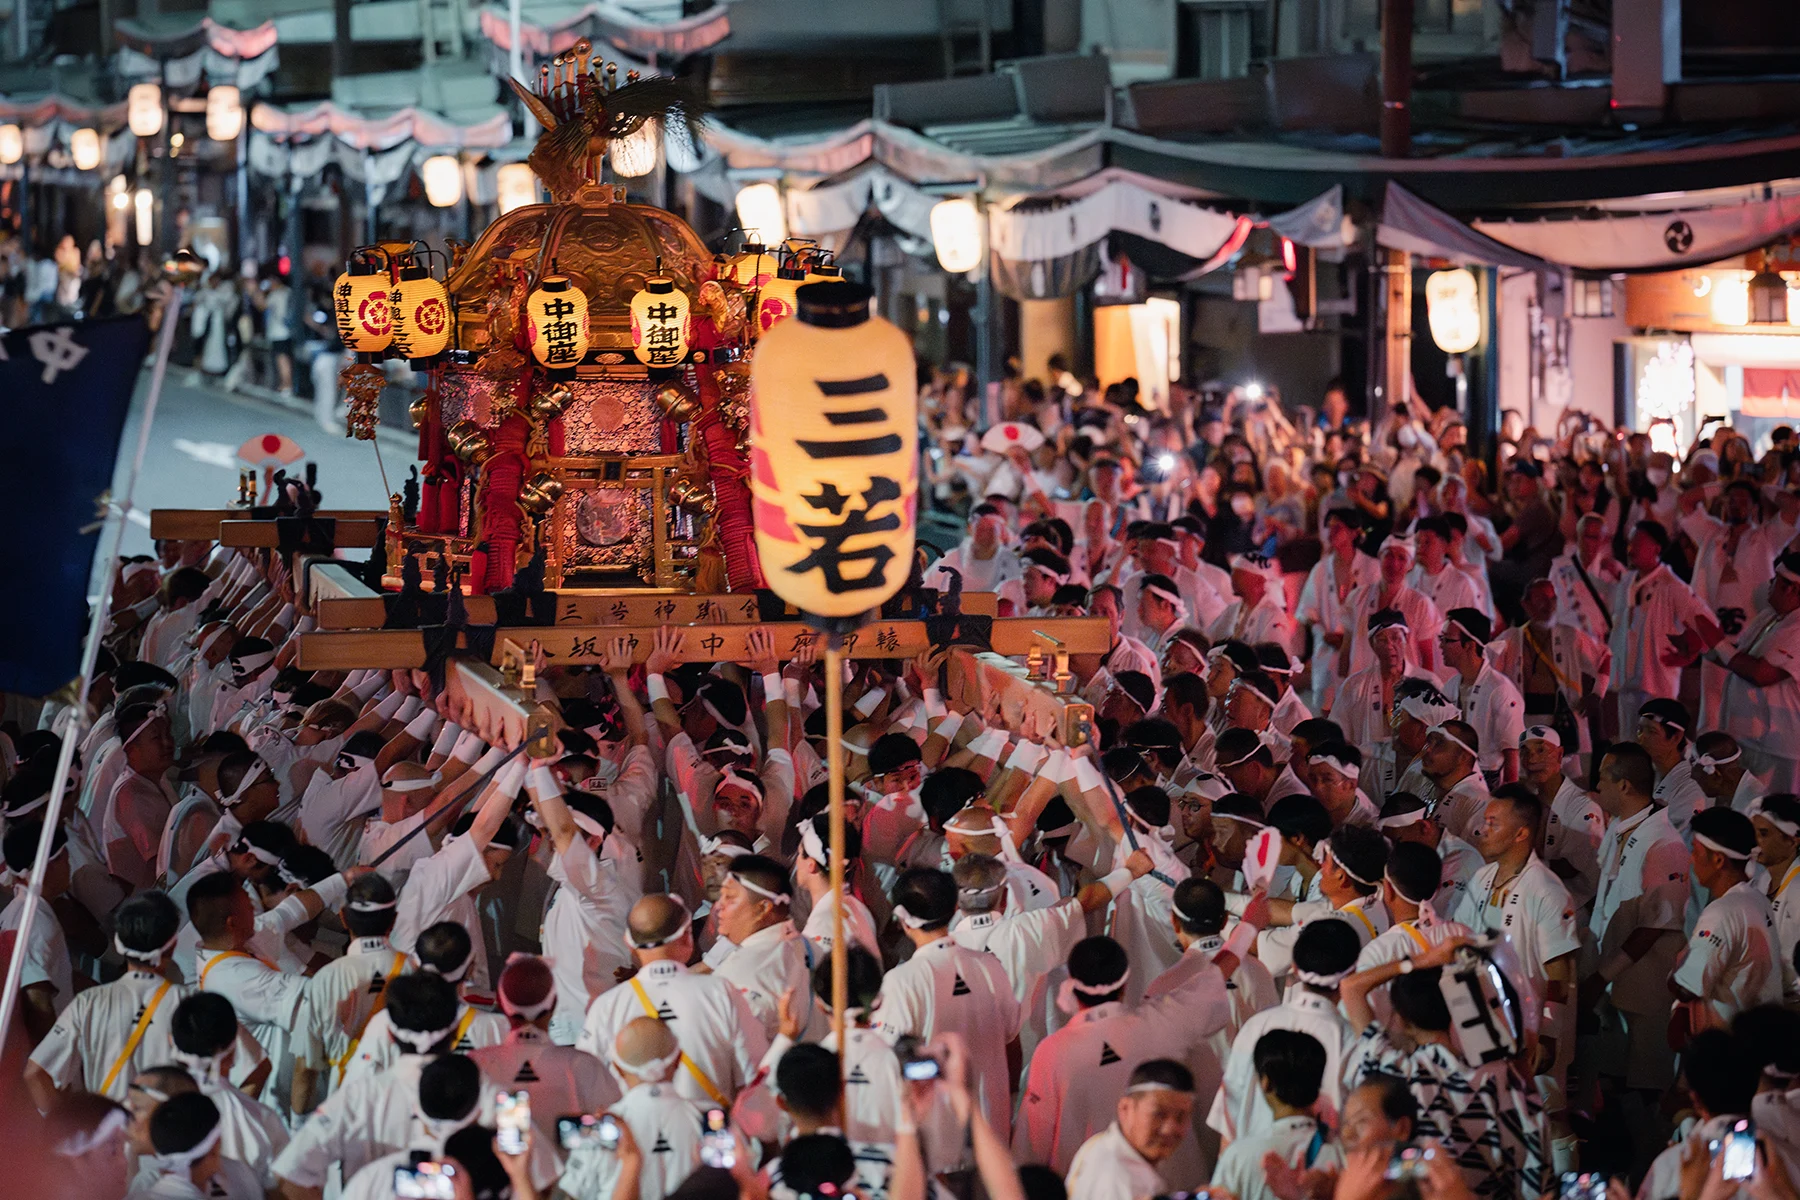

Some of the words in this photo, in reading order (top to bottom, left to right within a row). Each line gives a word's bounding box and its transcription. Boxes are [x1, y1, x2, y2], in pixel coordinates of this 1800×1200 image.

[542, 298, 580, 365] 中御座
[647, 302, 680, 365] 中御座
[783, 372, 903, 595] 三若
